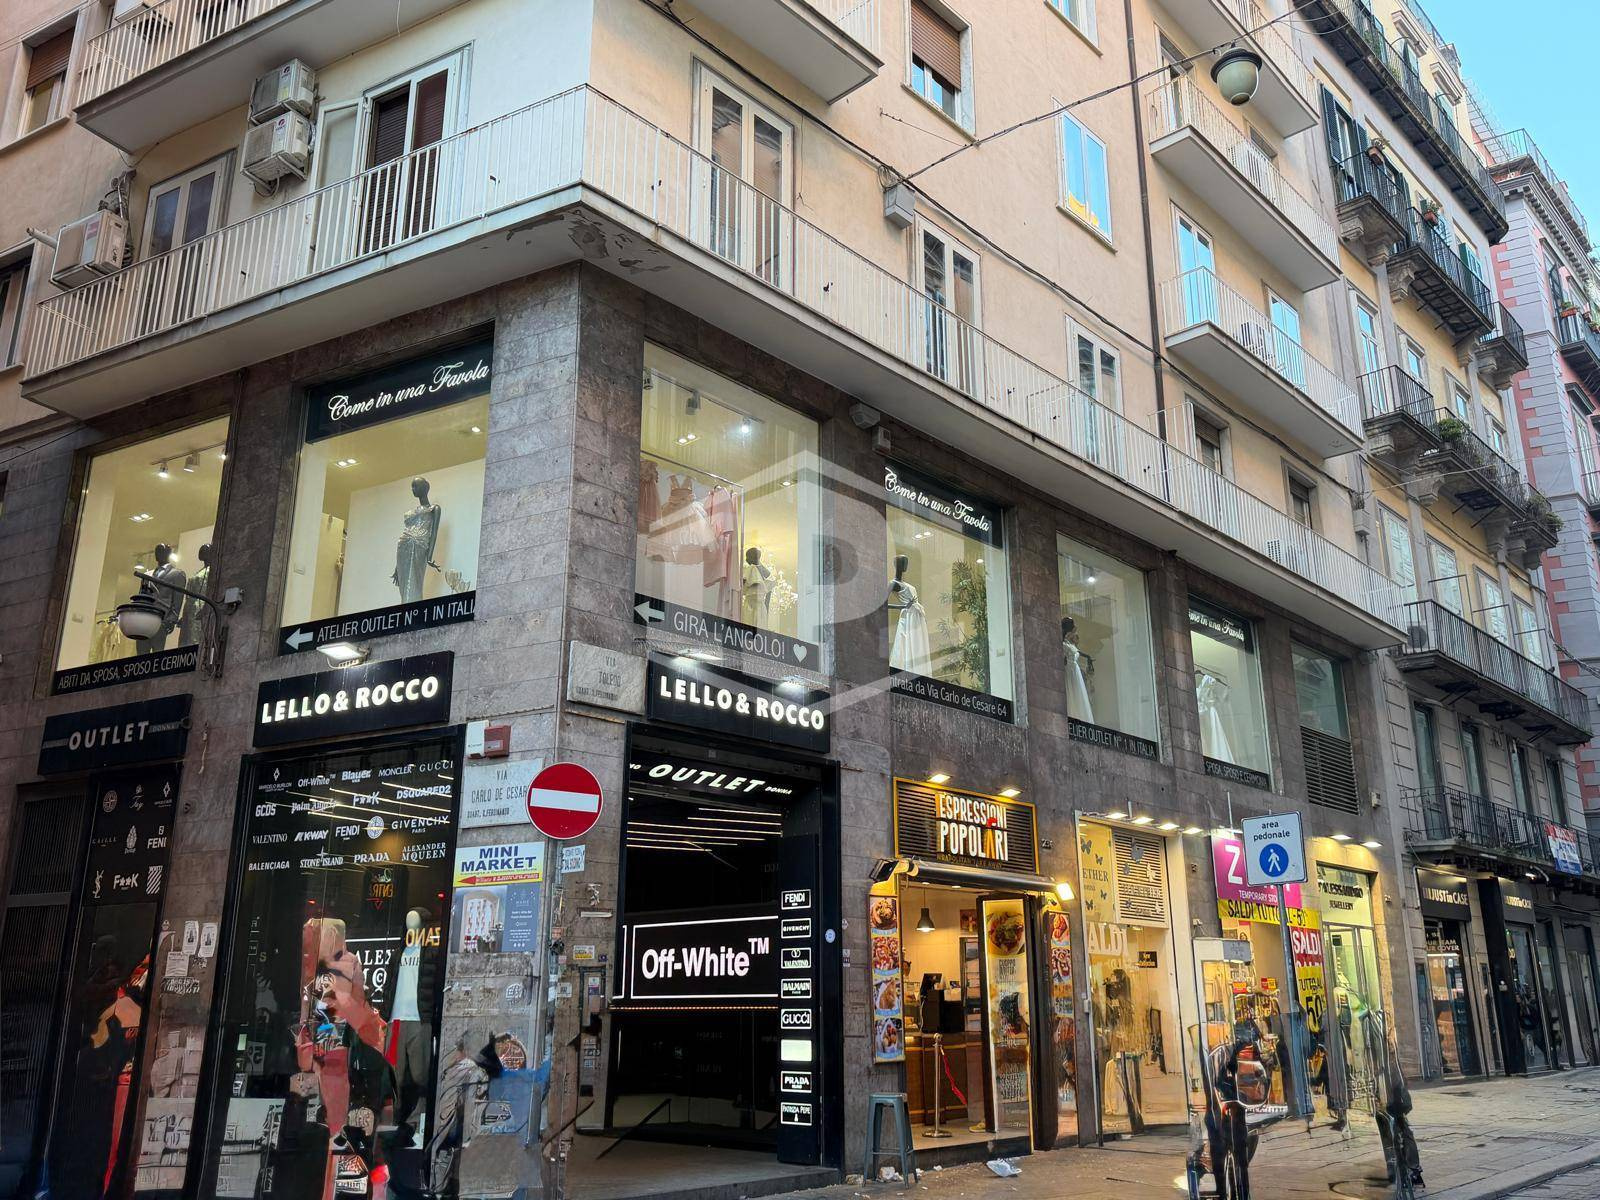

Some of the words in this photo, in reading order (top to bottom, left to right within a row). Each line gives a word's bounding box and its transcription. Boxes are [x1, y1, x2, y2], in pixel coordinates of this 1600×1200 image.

[328, 394, 373, 421] Come
[375, 391, 393, 409] in
[395, 384, 426, 402] una
[428, 359, 490, 393] Favola
[884, 466, 917, 502] Come
[917, 491, 930, 508] in
[930, 499, 951, 516] una
[952, 499, 990, 532] Favola
[317, 620, 358, 643] ATELIER
[361, 612, 402, 634] OUTLET
[404, 609, 419, 627] N°
[423, 608, 428, 622] 1
[432, 605, 444, 622] IN
[673, 611, 709, 639] GIRA
[713, 625, 786, 660] L'ANGOLO!
[57, 674, 78, 689] ABITI
[80, 671, 91, 685] DA
[92, 667, 121, 683] SPOSA,
[123, 662, 150, 678] SPOSO
[152, 658, 160, 673] E
[355, 675, 439, 709] ROCCO
[915, 681, 926, 696] da
[927, 683, 940, 699] Via
[940, 687, 960, 704] Carlo
[961, 693, 971, 707] de
[972, 696, 996, 714] Cesare
[997, 703, 1007, 717] 64
[756, 696, 825, 731] ROCCO
[68, 720, 150, 751] OUTLET
[1089, 728, 1112, 746] OUTLET
[379, 766, 412, 777] MONCLER
[419, 760, 454, 773] GUCCI
[342, 768, 372, 782] Blauer
[496, 770, 508, 781] VIA
[649, 764, 766, 793] OUTLET
[471, 788, 492, 803] CARLO
[495, 787, 503, 800] DE
[506, 785, 528, 800] CESAR
[255, 803, 277, 818] GCDS
[939, 792, 1008, 829] ESPRESSIONI
[391, 815, 449, 830] GIVENCHY
[1261, 820, 1279, 829] area
[335, 824, 360, 838] FENDI
[1253, 829, 1291, 842] pedonale
[252, 833, 288, 844] VALENTINO
[940, 820, 1009, 862] POPOLARI
[402, 842, 446, 853] ALEXANDER
[479, 845, 519, 859] MINI
[299, 858, 320, 868] STONE
[322, 856, 343, 866] ISLAND
[354, 852, 390, 864] PRADA
[461, 856, 537, 873] MARKET
[249, 861, 290, 871] BALENCIAGA
[784, 893, 806, 904] FENDI
[1238, 889, 1268, 900] TEMPORARY
[1227, 898, 1254, 919] SALDI
[783, 924, 810, 932] GIVENCHY
[1292, 930, 1321, 954] SALDI
[783, 982, 810, 991] BALMAIN
[782, 1011, 811, 1025] GUCCI
[784, 1076, 810, 1086] PRADA
